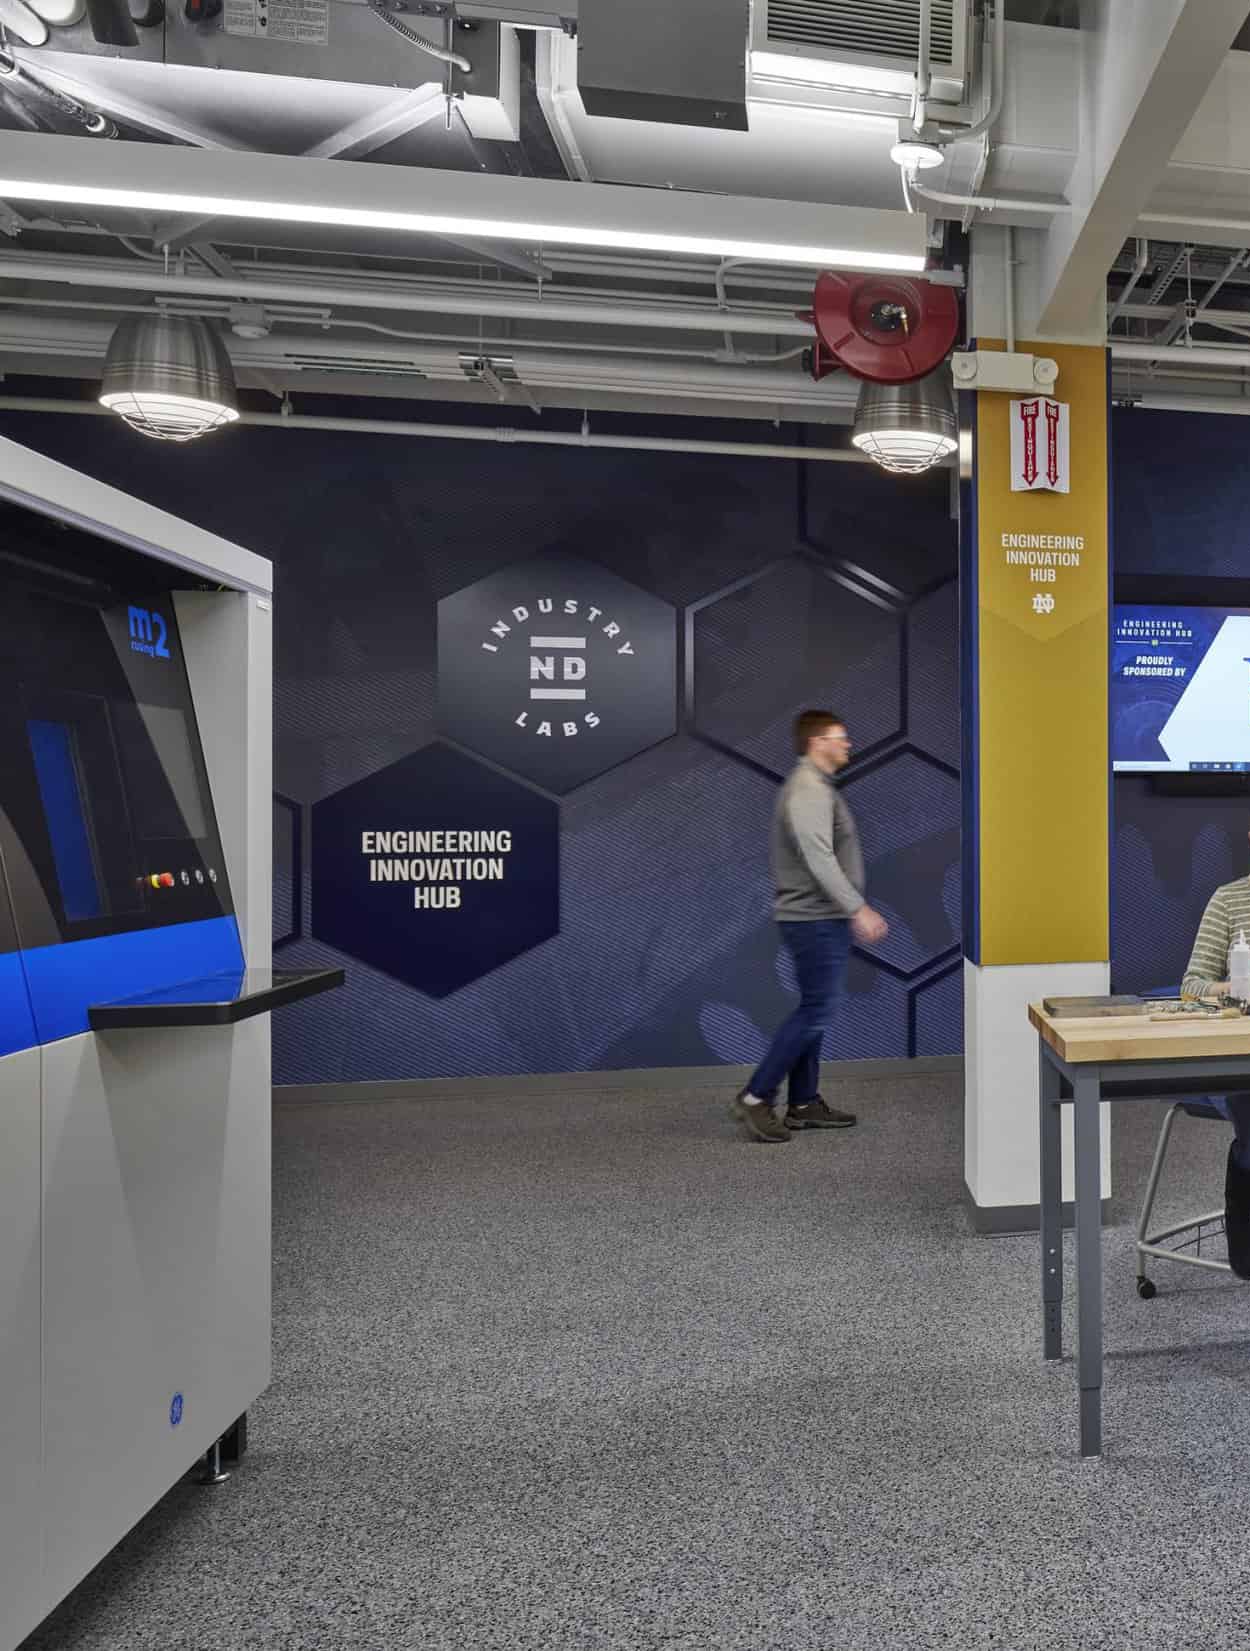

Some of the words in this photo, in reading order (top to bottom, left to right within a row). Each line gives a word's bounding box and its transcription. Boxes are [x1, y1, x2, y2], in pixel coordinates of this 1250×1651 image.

[1024, 406, 1037, 416] FIRE
[1048, 406, 1057, 417] FIRE
[1002, 533, 1084, 550] ENGINEERING
[1006, 550, 1080, 567] INNOVATION
[1030, 568, 1056, 582] HUB
[482, 598, 634, 655] INDUSTRY
[1117, 628, 1171, 637] INNOVATION
[1122, 619, 1183, 629] ENGINEERING
[530, 656, 586, 680] ND
[1136, 655, 1174, 665] PROUDLY
[1123, 666, 1173, 676] SPONSORED
[1174, 667, 1187, 677] BY
[515, 711, 600, 736] LABS
[362, 830, 512, 853] ENGINEERING
[370, 858, 504, 881] INNOVATION
[414, 886, 461, 909] HUB
